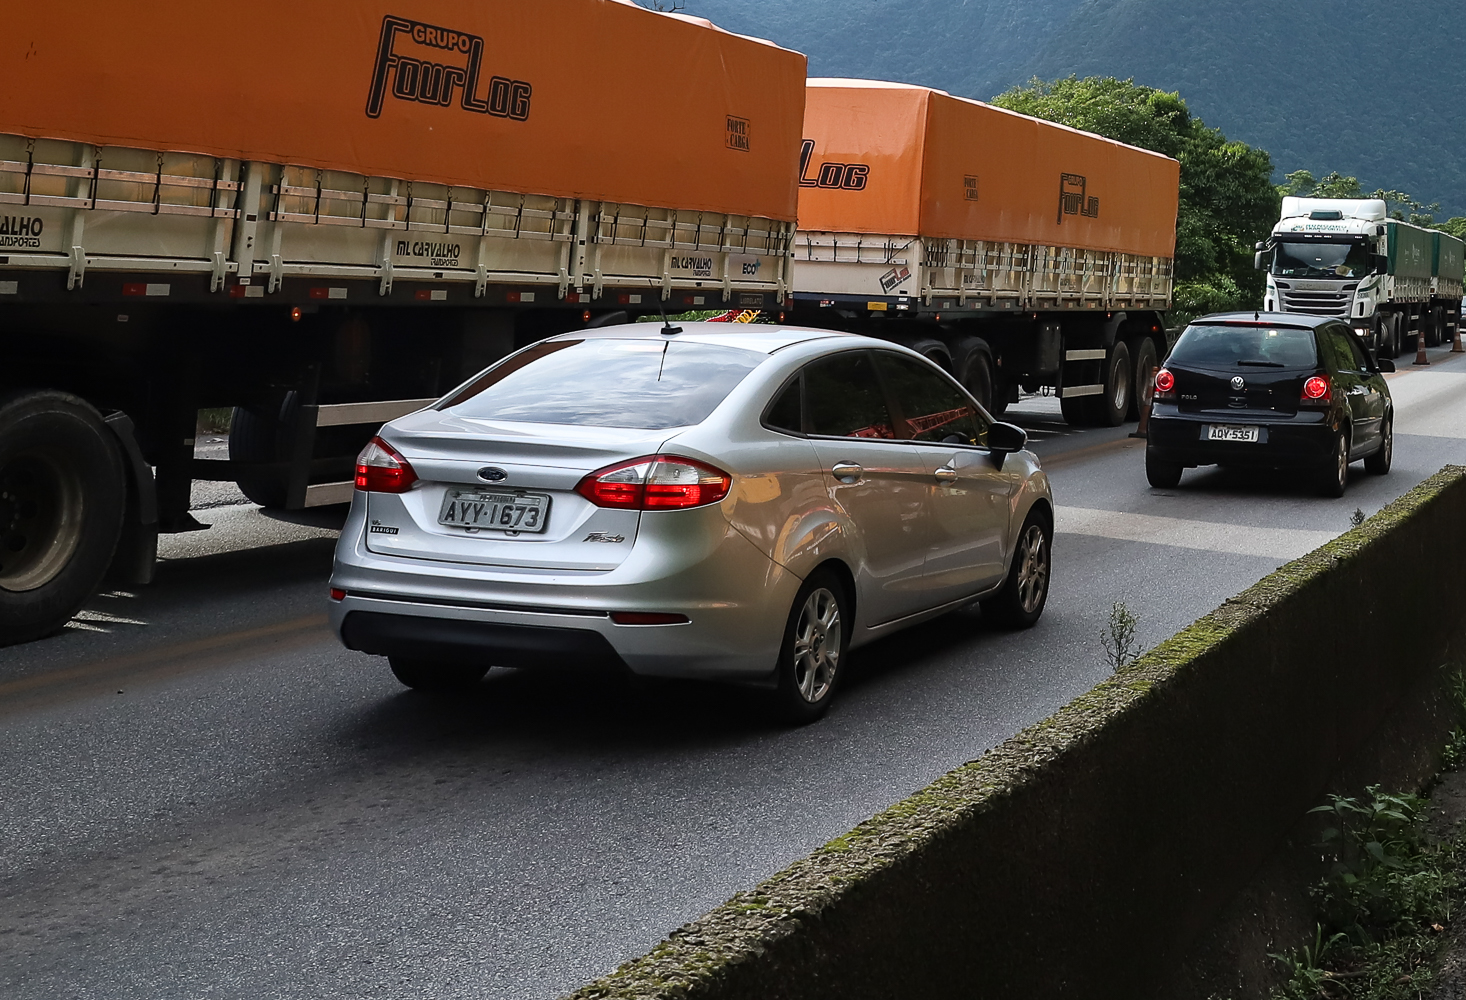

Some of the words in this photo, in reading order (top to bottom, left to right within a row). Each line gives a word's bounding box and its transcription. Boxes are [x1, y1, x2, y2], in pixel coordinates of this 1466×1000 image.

[412, 24, 470, 53] GRUPO
[726, 118, 746, 135] FORTE
[730, 134, 749, 150] CARGA
[0, 216, 43, 237] ALHO
[396, 240, 411, 256] ML
[412, 241, 460, 259] CARVALHO
[681, 256, 712, 270] CARVALHO
[371, 526, 398, 534] BARIGUI
